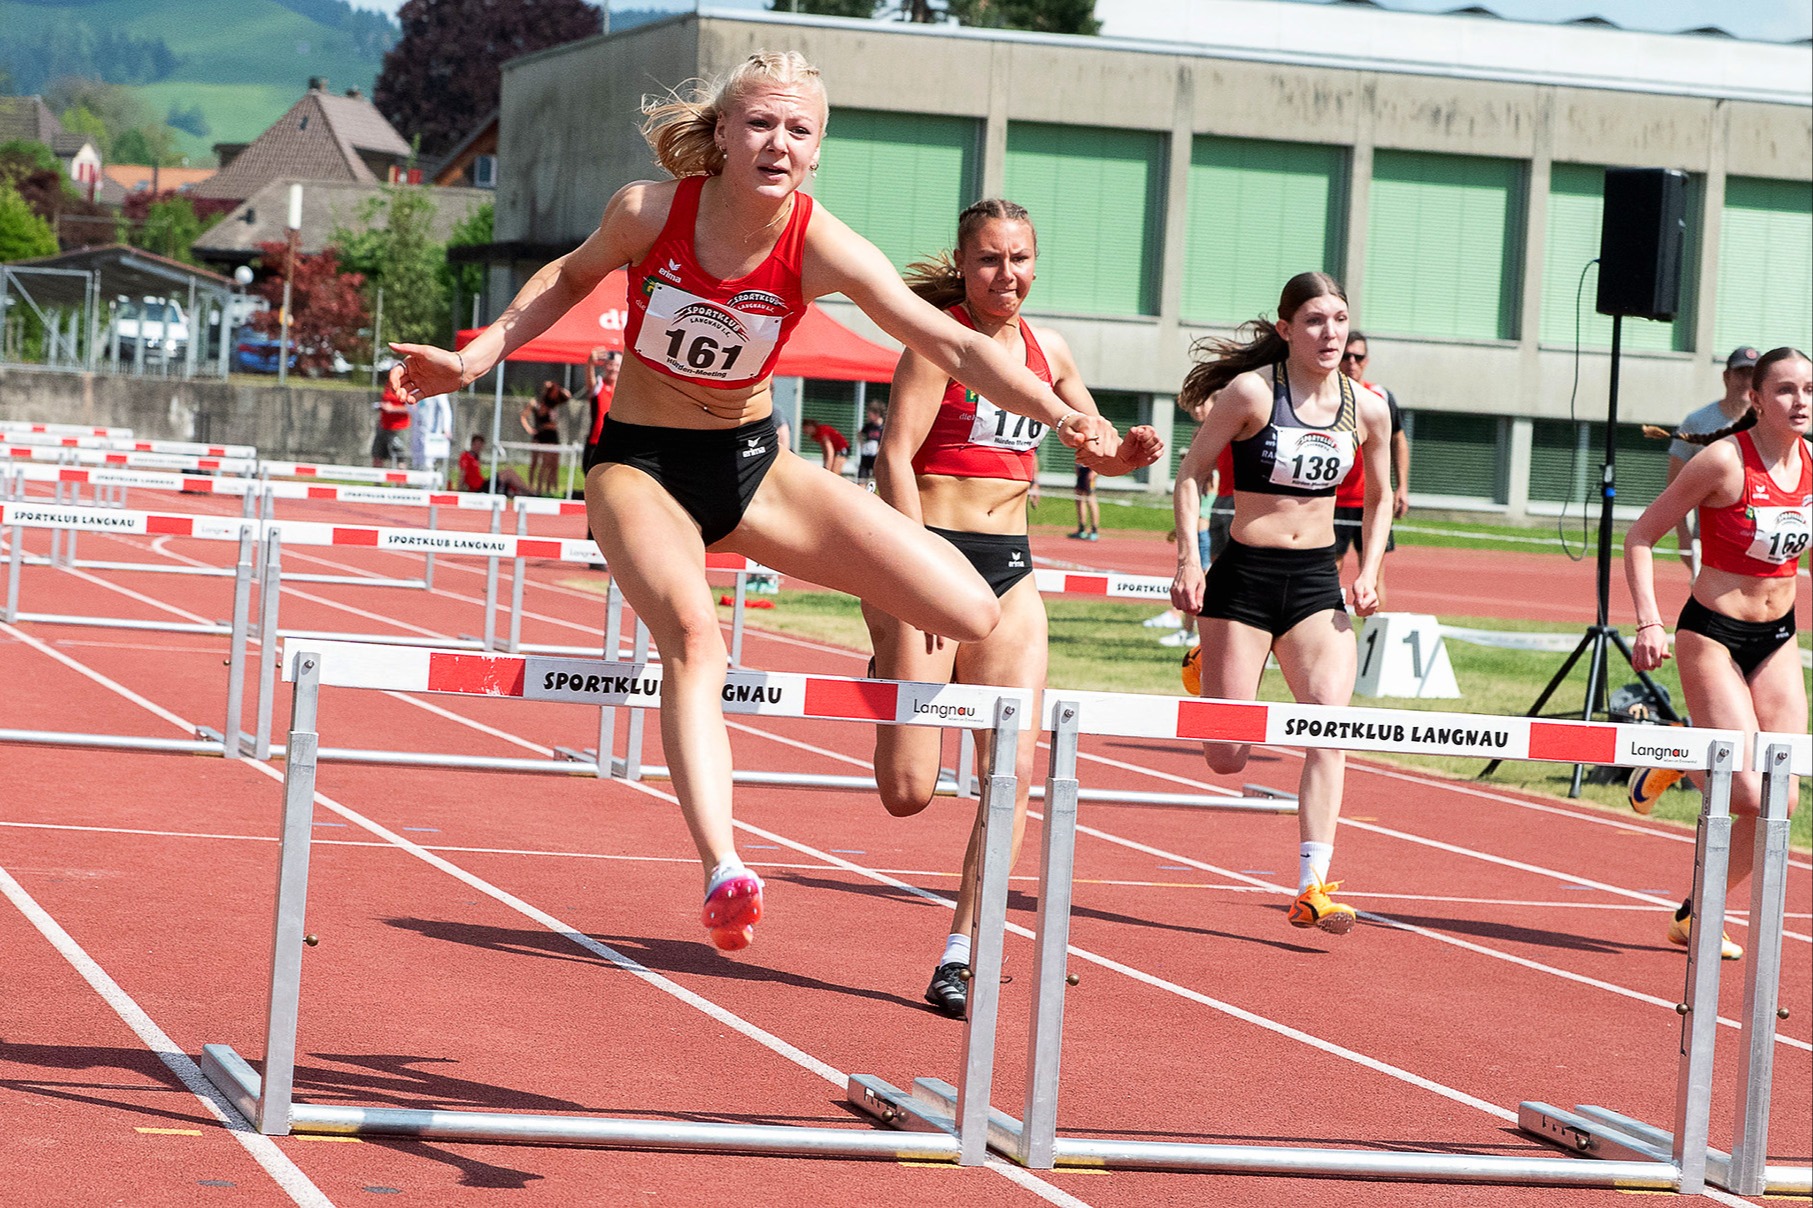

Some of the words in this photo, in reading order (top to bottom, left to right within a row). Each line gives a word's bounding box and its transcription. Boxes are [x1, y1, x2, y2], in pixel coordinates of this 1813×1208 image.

[733, 293, 780, 306] SPORTKLUB
[687, 306, 740, 332] SPORTKLUB
[690, 318, 722, 330] LANGNAU
[665, 328, 743, 370] 161
[666, 358, 728, 379] Hürden-Meeting
[994, 409, 1043, 440] 176
[1261, 449, 1276, 459] RA
[1291, 454, 1341, 481] 138
[14, 511, 79, 523] SPORTKLUB
[82, 516, 135, 528] LANGNAU
[388, 535, 450, 548] SPORTKLUB
[454, 540, 506, 551] LANGNAU
[1768, 532, 1809, 556] 168
[1117, 583, 1170, 594] SPORTKLU
[1361, 628, 1378, 678] 1
[1402, 630, 1422, 678] 1
[543, 671, 662, 697] SPORTKLU
[722, 684, 783, 704] GNAU
[913, 698, 976, 719] Langnau
[1285, 718, 1405, 742] SPORTKLUB
[1411, 726, 1509, 748] LANGNAU
[1631, 741, 1689, 761] Langnau
